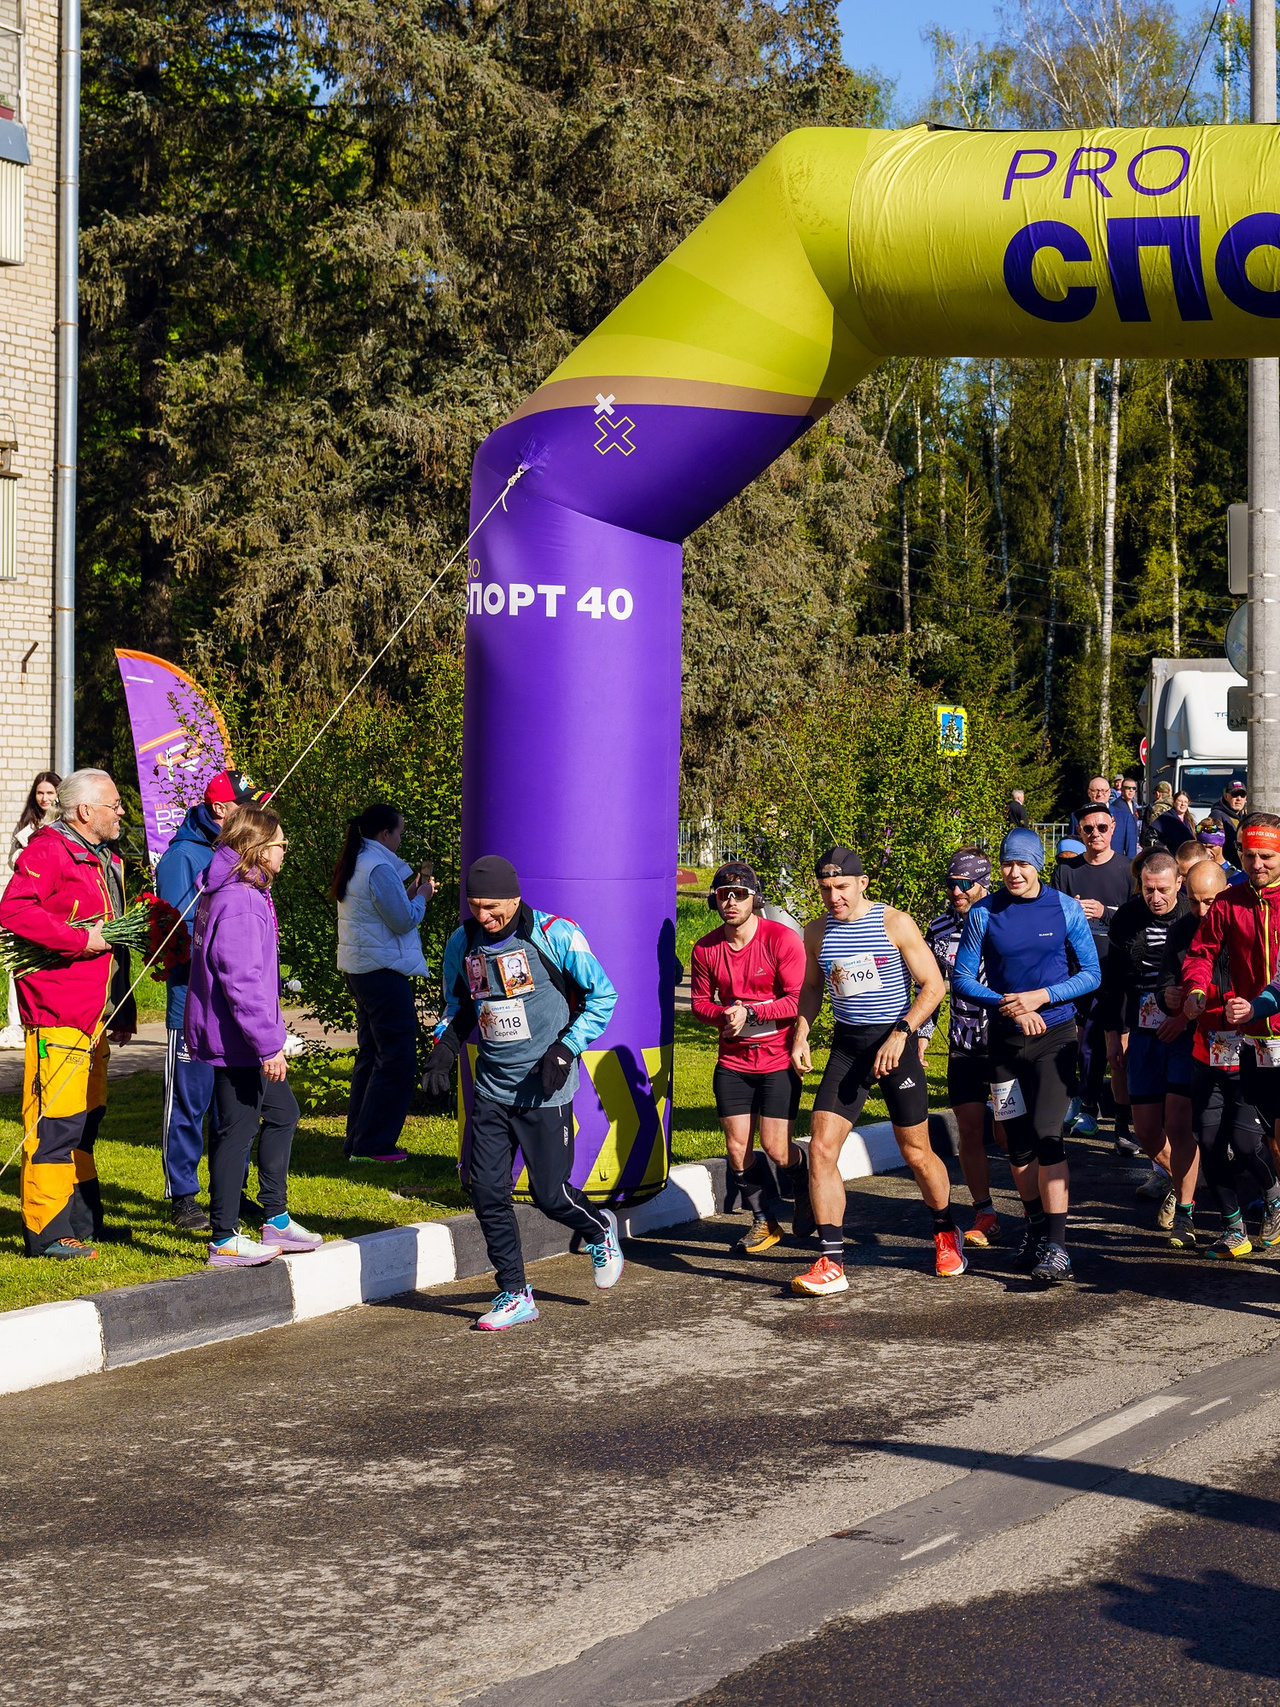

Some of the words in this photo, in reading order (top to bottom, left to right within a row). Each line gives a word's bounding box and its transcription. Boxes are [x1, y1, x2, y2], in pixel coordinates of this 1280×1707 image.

[1002, 145, 1191, 200] PRO
[577, 586, 634, 620] 40
[850, 969, 873, 982] 196
[499, 1017, 521, 1028] 118
[1000, 1097, 1016, 1108] 54
[995, 1109, 1016, 1117] Степан
